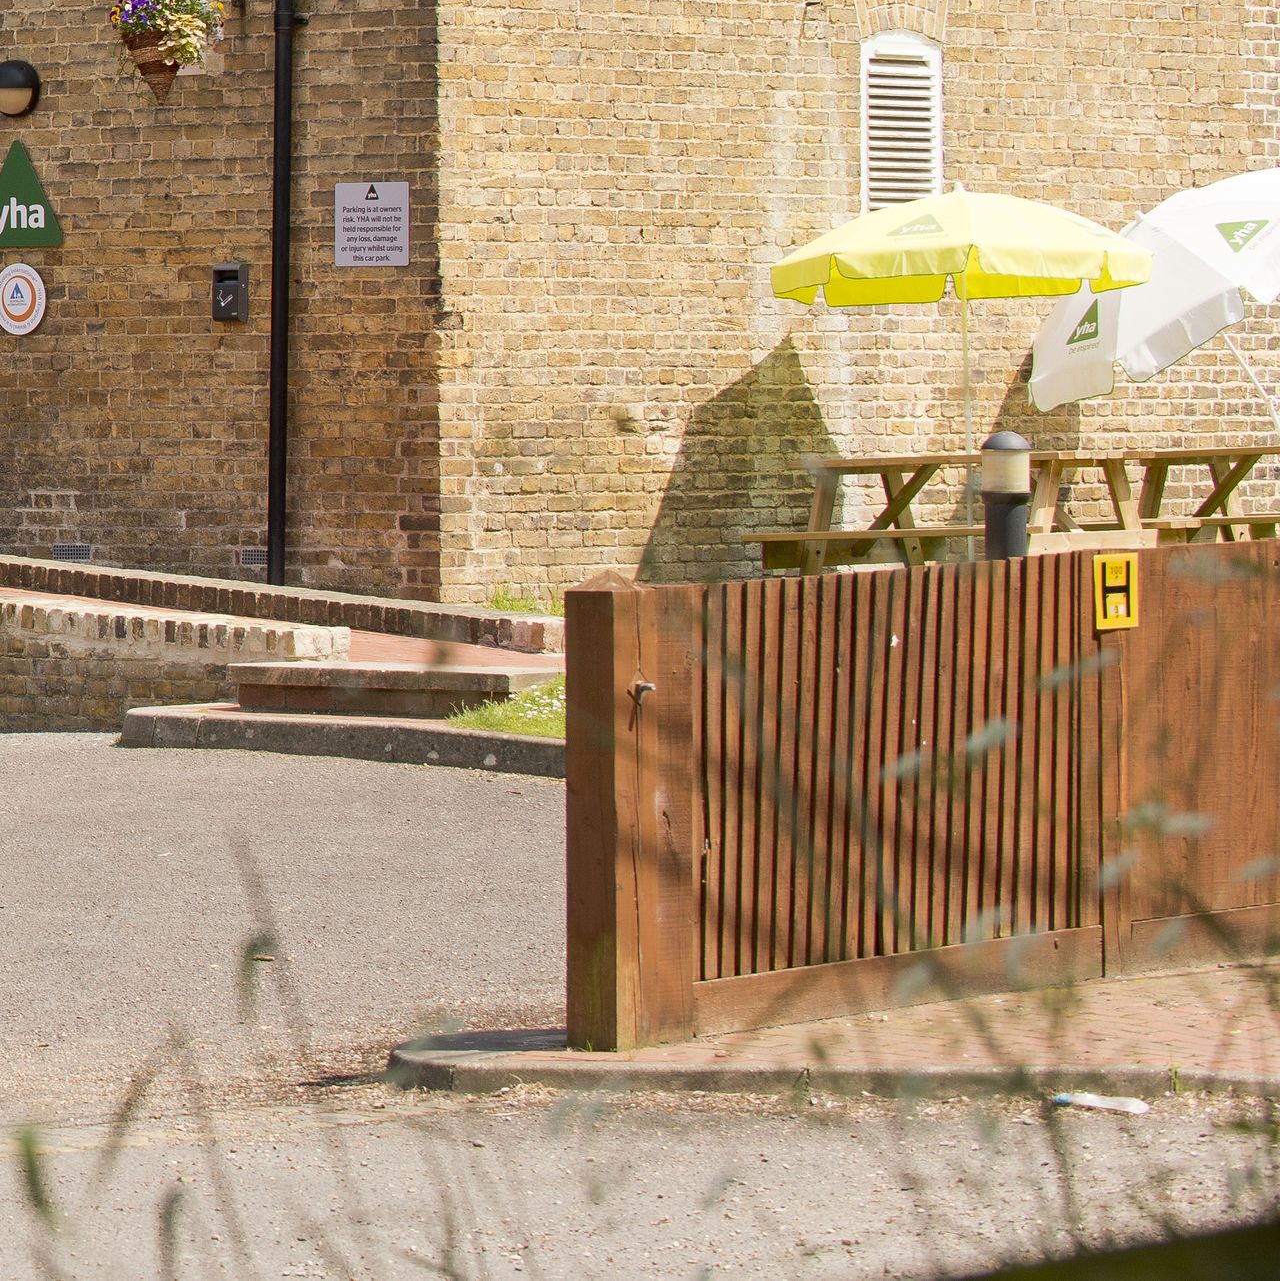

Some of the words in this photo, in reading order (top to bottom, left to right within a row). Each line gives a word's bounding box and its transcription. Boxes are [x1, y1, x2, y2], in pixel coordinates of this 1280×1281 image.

[342, 206, 366, 214] Parking
[342, 215, 355, 223] risk.
[356, 225, 391, 234] responsible
[900, 223, 937, 235] yha
[1228, 222, 1258, 246] yha
[372, 235, 397, 243] damage
[348, 245, 366, 253] injury
[386, 245, 403, 253] using
[1073, 321, 1097, 340] yha
[1101, 560, 1131, 619] H
